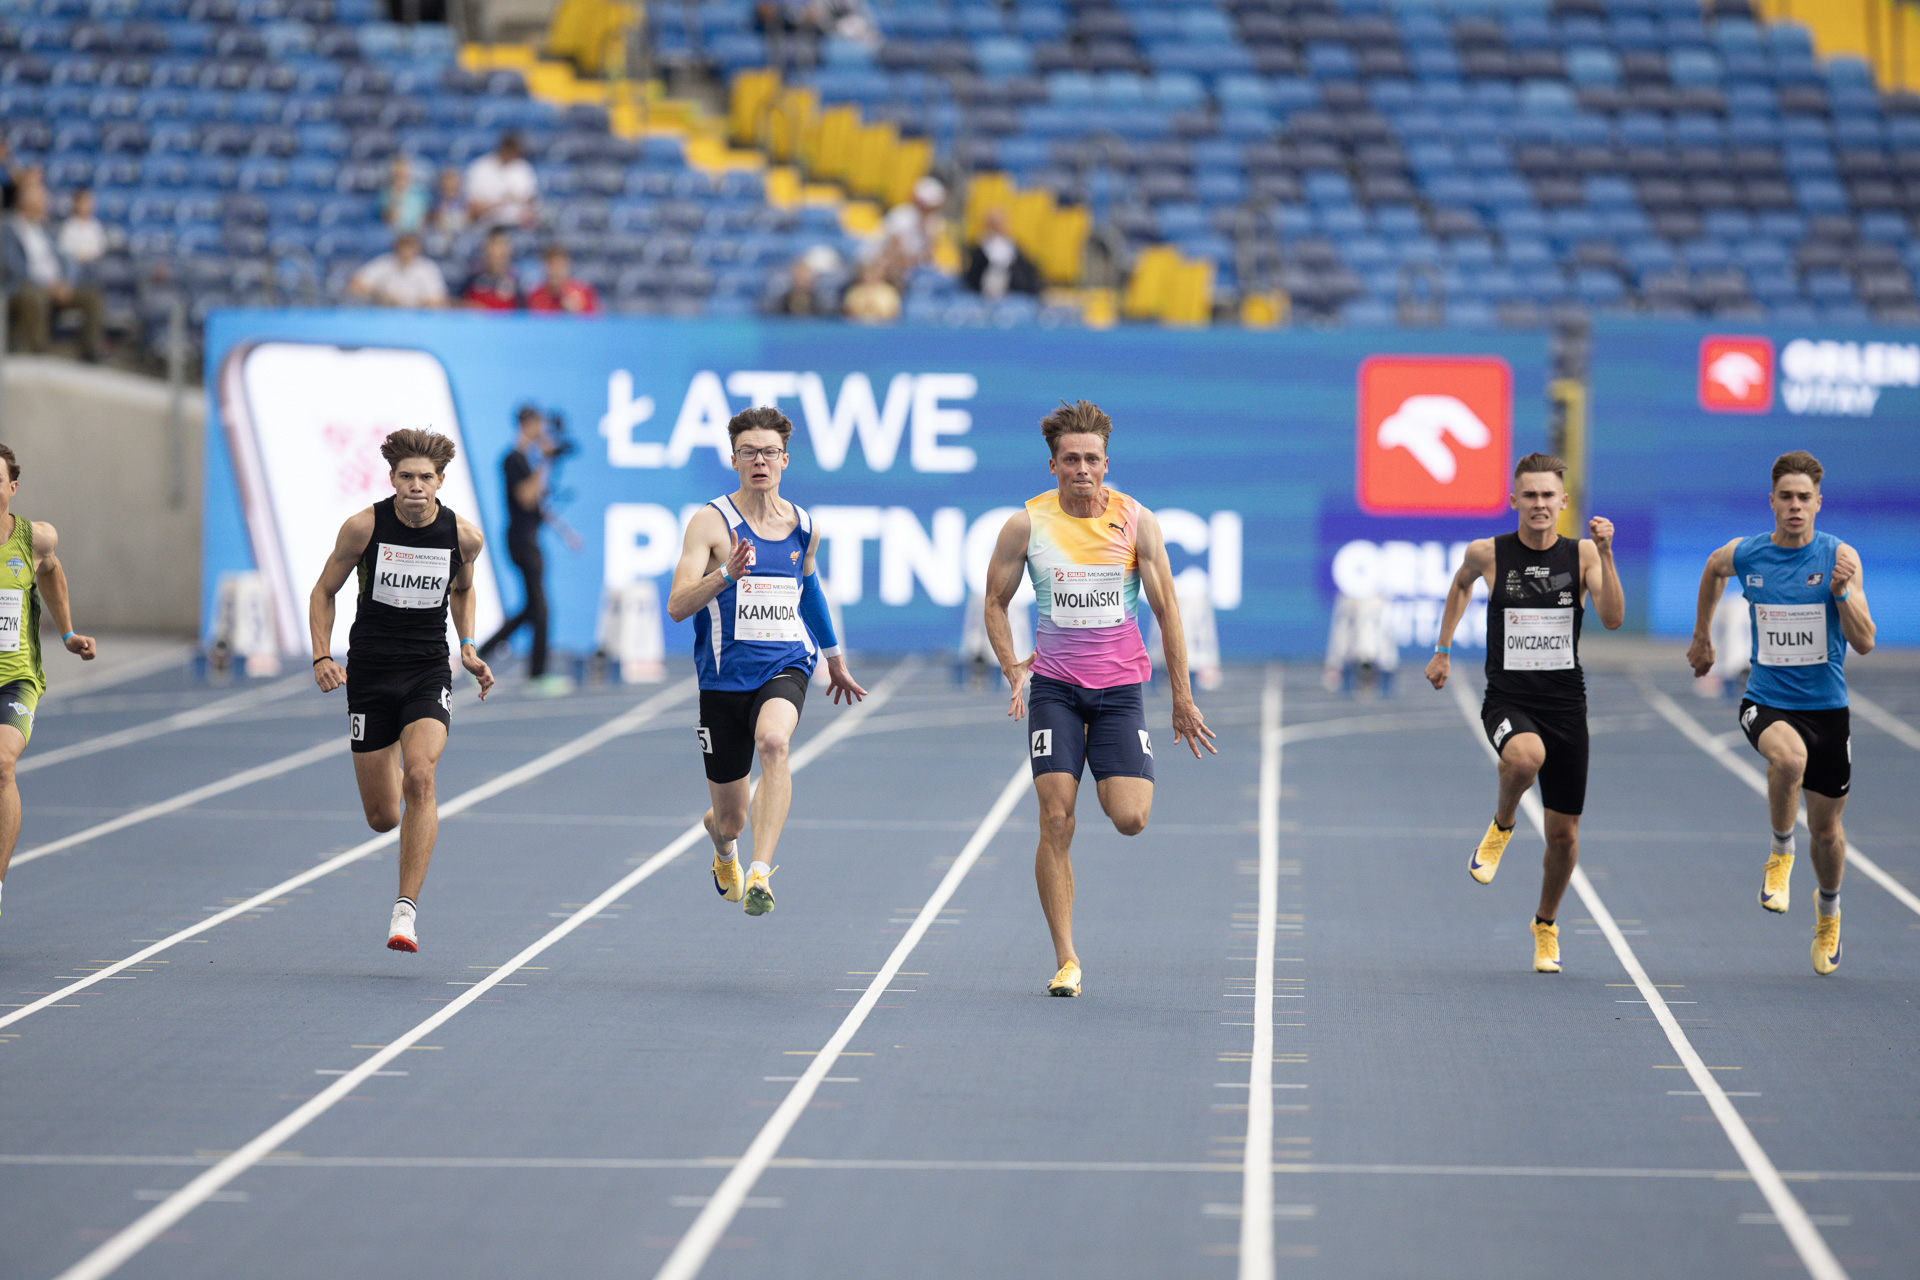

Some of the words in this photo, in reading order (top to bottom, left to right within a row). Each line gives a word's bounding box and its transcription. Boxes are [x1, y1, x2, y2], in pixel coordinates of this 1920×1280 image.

[380, 572, 442, 590] KLIMEK
[1054, 590, 1119, 608] WOLIŃSKI
[738, 605, 796, 621] KAMUDA
[1507, 635, 1570, 650] OWCZARCZYK
[1766, 631, 1813, 646] TULIN
[352, 716, 360, 738] 6
[697, 730, 708, 751] 5
[1034, 732, 1047, 754] 4
